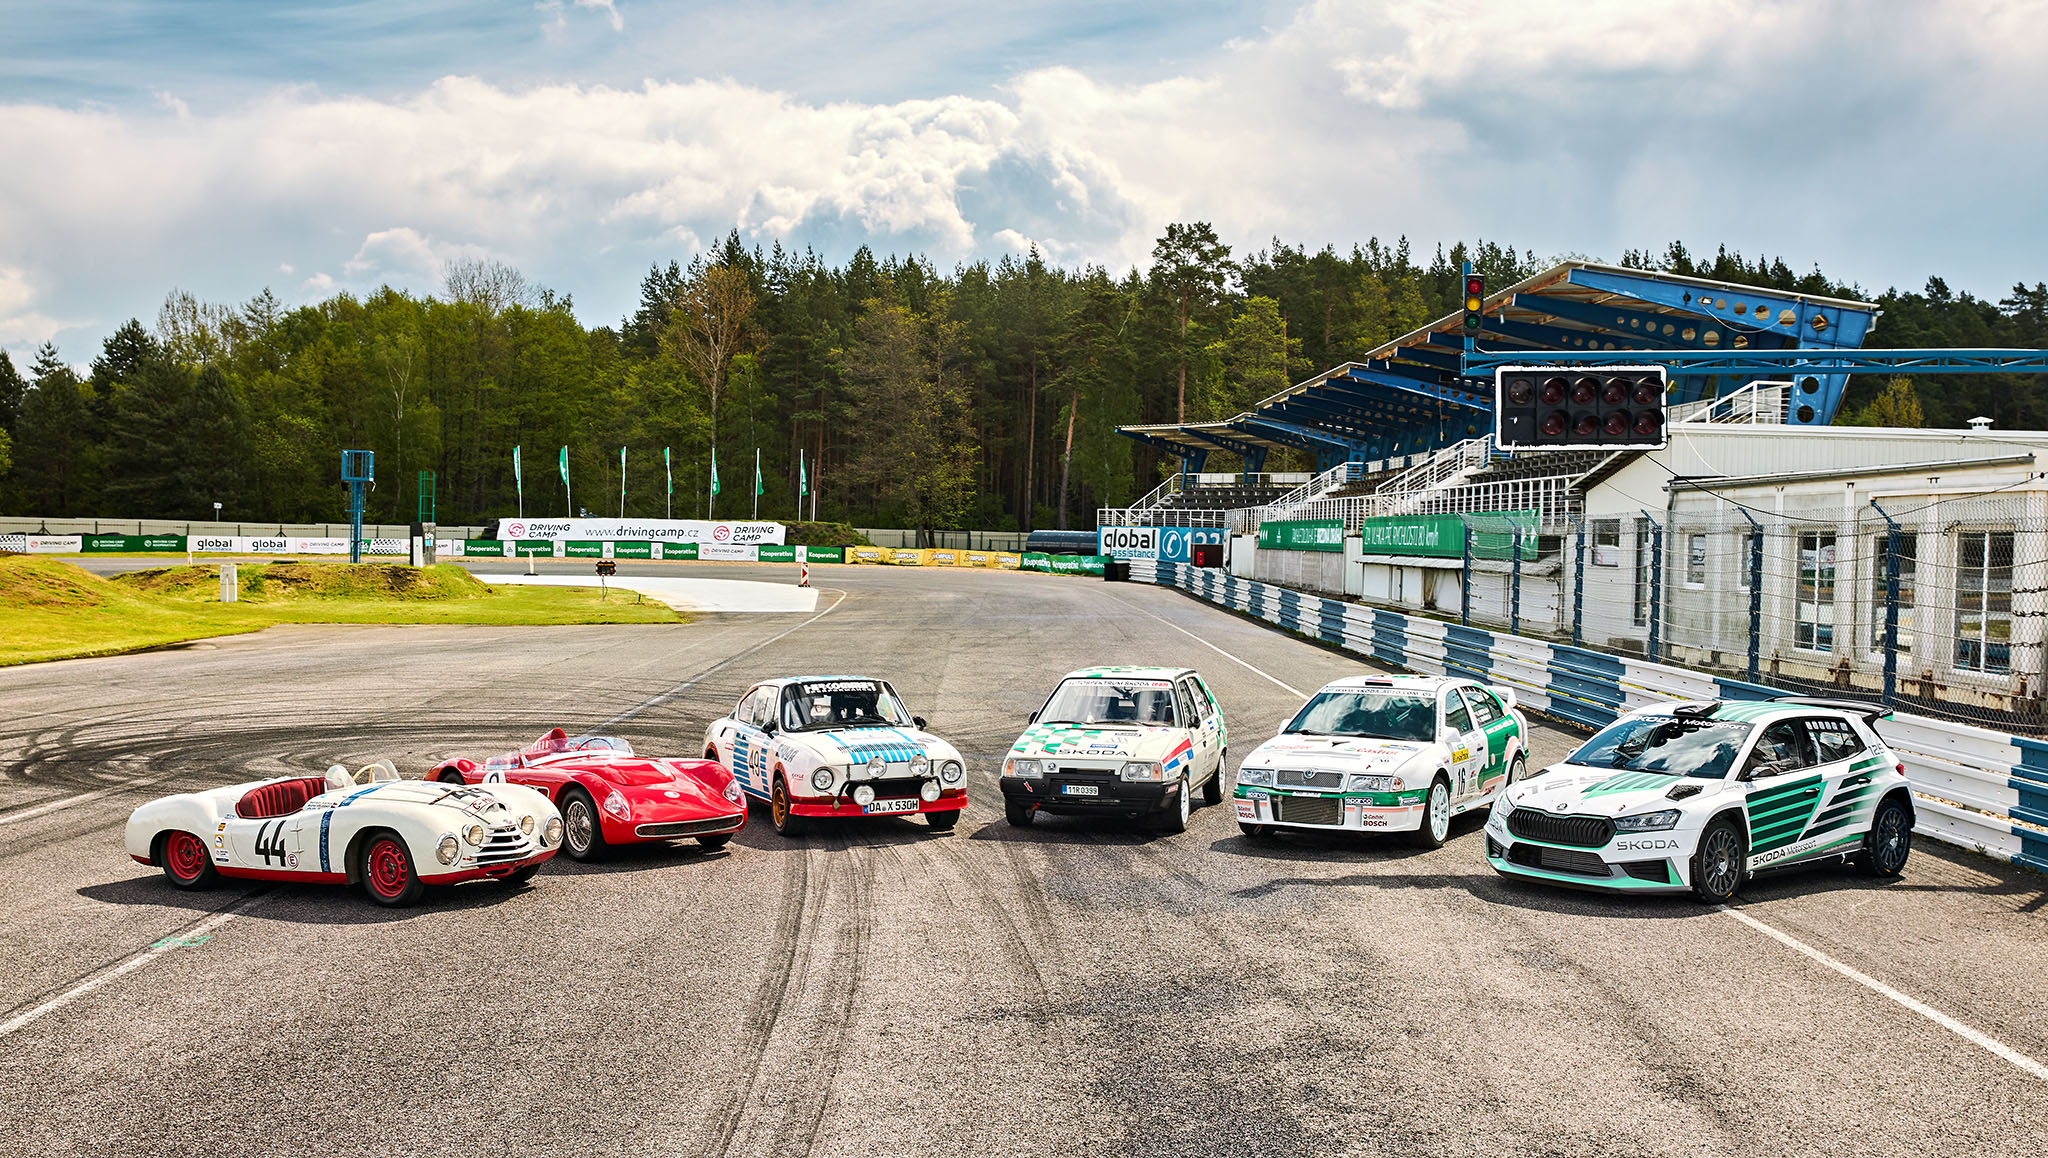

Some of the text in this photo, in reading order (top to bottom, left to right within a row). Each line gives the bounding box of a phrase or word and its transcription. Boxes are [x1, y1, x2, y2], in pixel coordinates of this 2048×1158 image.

[530, 524, 570, 532] DRIVING
[585, 526, 699, 540] www.drivingcamp.cz
[197, 539, 232, 550] global
[1104, 529, 1156, 549] global
[252, 540, 286, 551] global
[1112, 550, 1155, 558] assistance
[1683, 719, 1747, 730] Motorsport
[1868, 744, 1885, 756] 125
[749, 750, 760, 776] 49
[1458, 768, 1466, 798] 16
[870, 800, 918, 812] DA X 530H
[255, 820, 286, 867] 44
[1786, 840, 1816, 855] Motorsport
